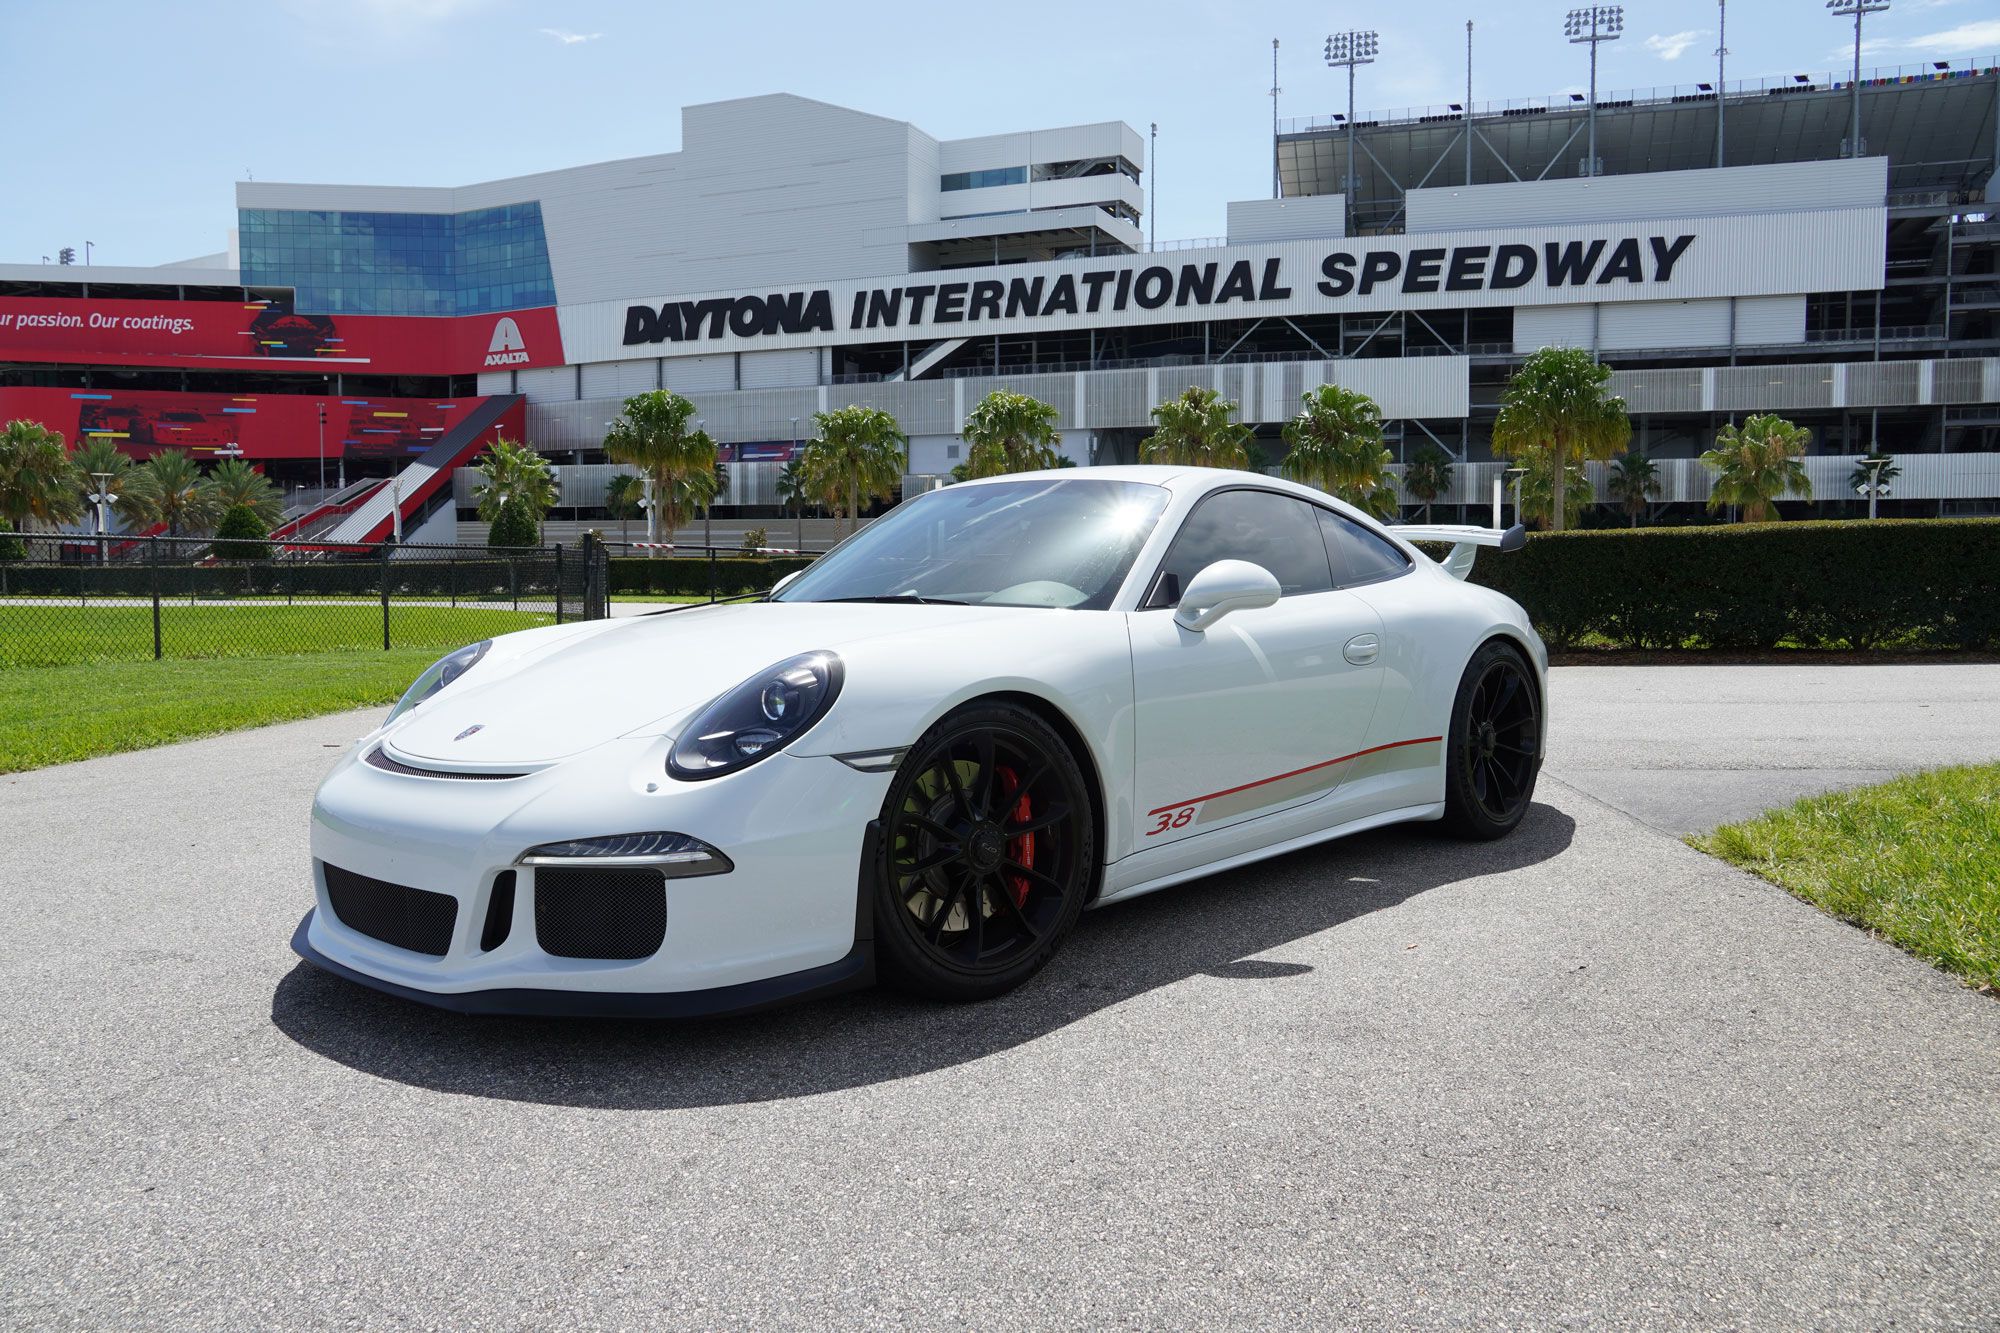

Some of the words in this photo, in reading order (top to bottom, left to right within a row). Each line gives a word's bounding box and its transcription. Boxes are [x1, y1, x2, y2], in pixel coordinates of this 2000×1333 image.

[622, 289, 835, 346] DAYTONA
[849, 257, 1292, 330] INTERNATIONAL
[1317, 234, 1696, 298] SPEEDWAY
[16, 312, 84, 331] passion.
[89, 312, 120, 329] Our
[122, 314, 194, 334] coatings.
[484, 351, 530, 366] AXALTA
[1145, 806, 1196, 836] 3.8
